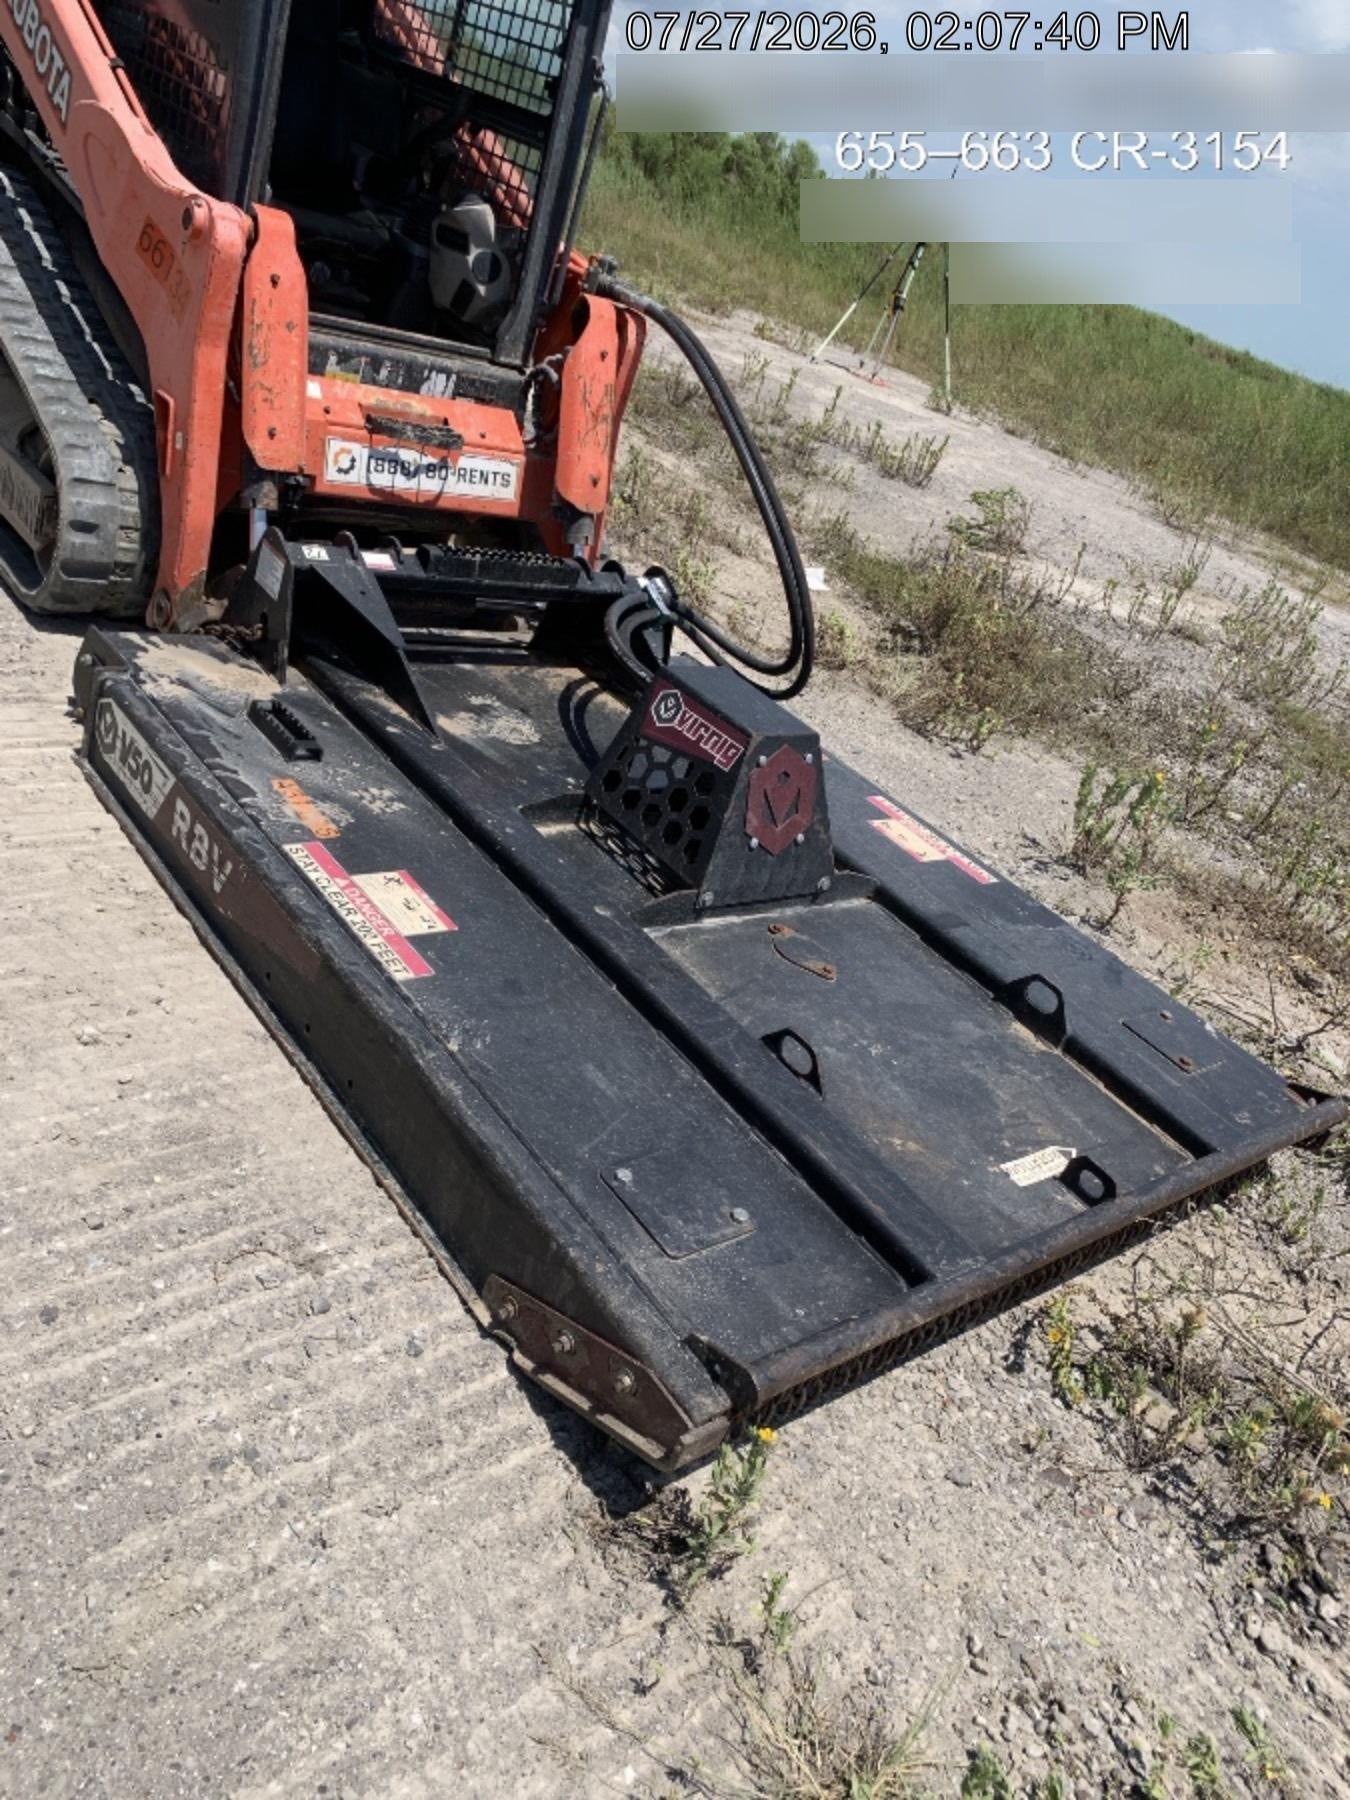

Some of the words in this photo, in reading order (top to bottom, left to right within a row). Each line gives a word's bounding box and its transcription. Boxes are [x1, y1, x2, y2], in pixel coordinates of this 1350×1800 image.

[8, 0, 71, 123] UBOTA
[289, 847, 321, 877] STAY
[315, 876, 358, 918] CLEAR
[370, 941, 410, 976] FEET
[346, 888, 396, 937] DANGER
